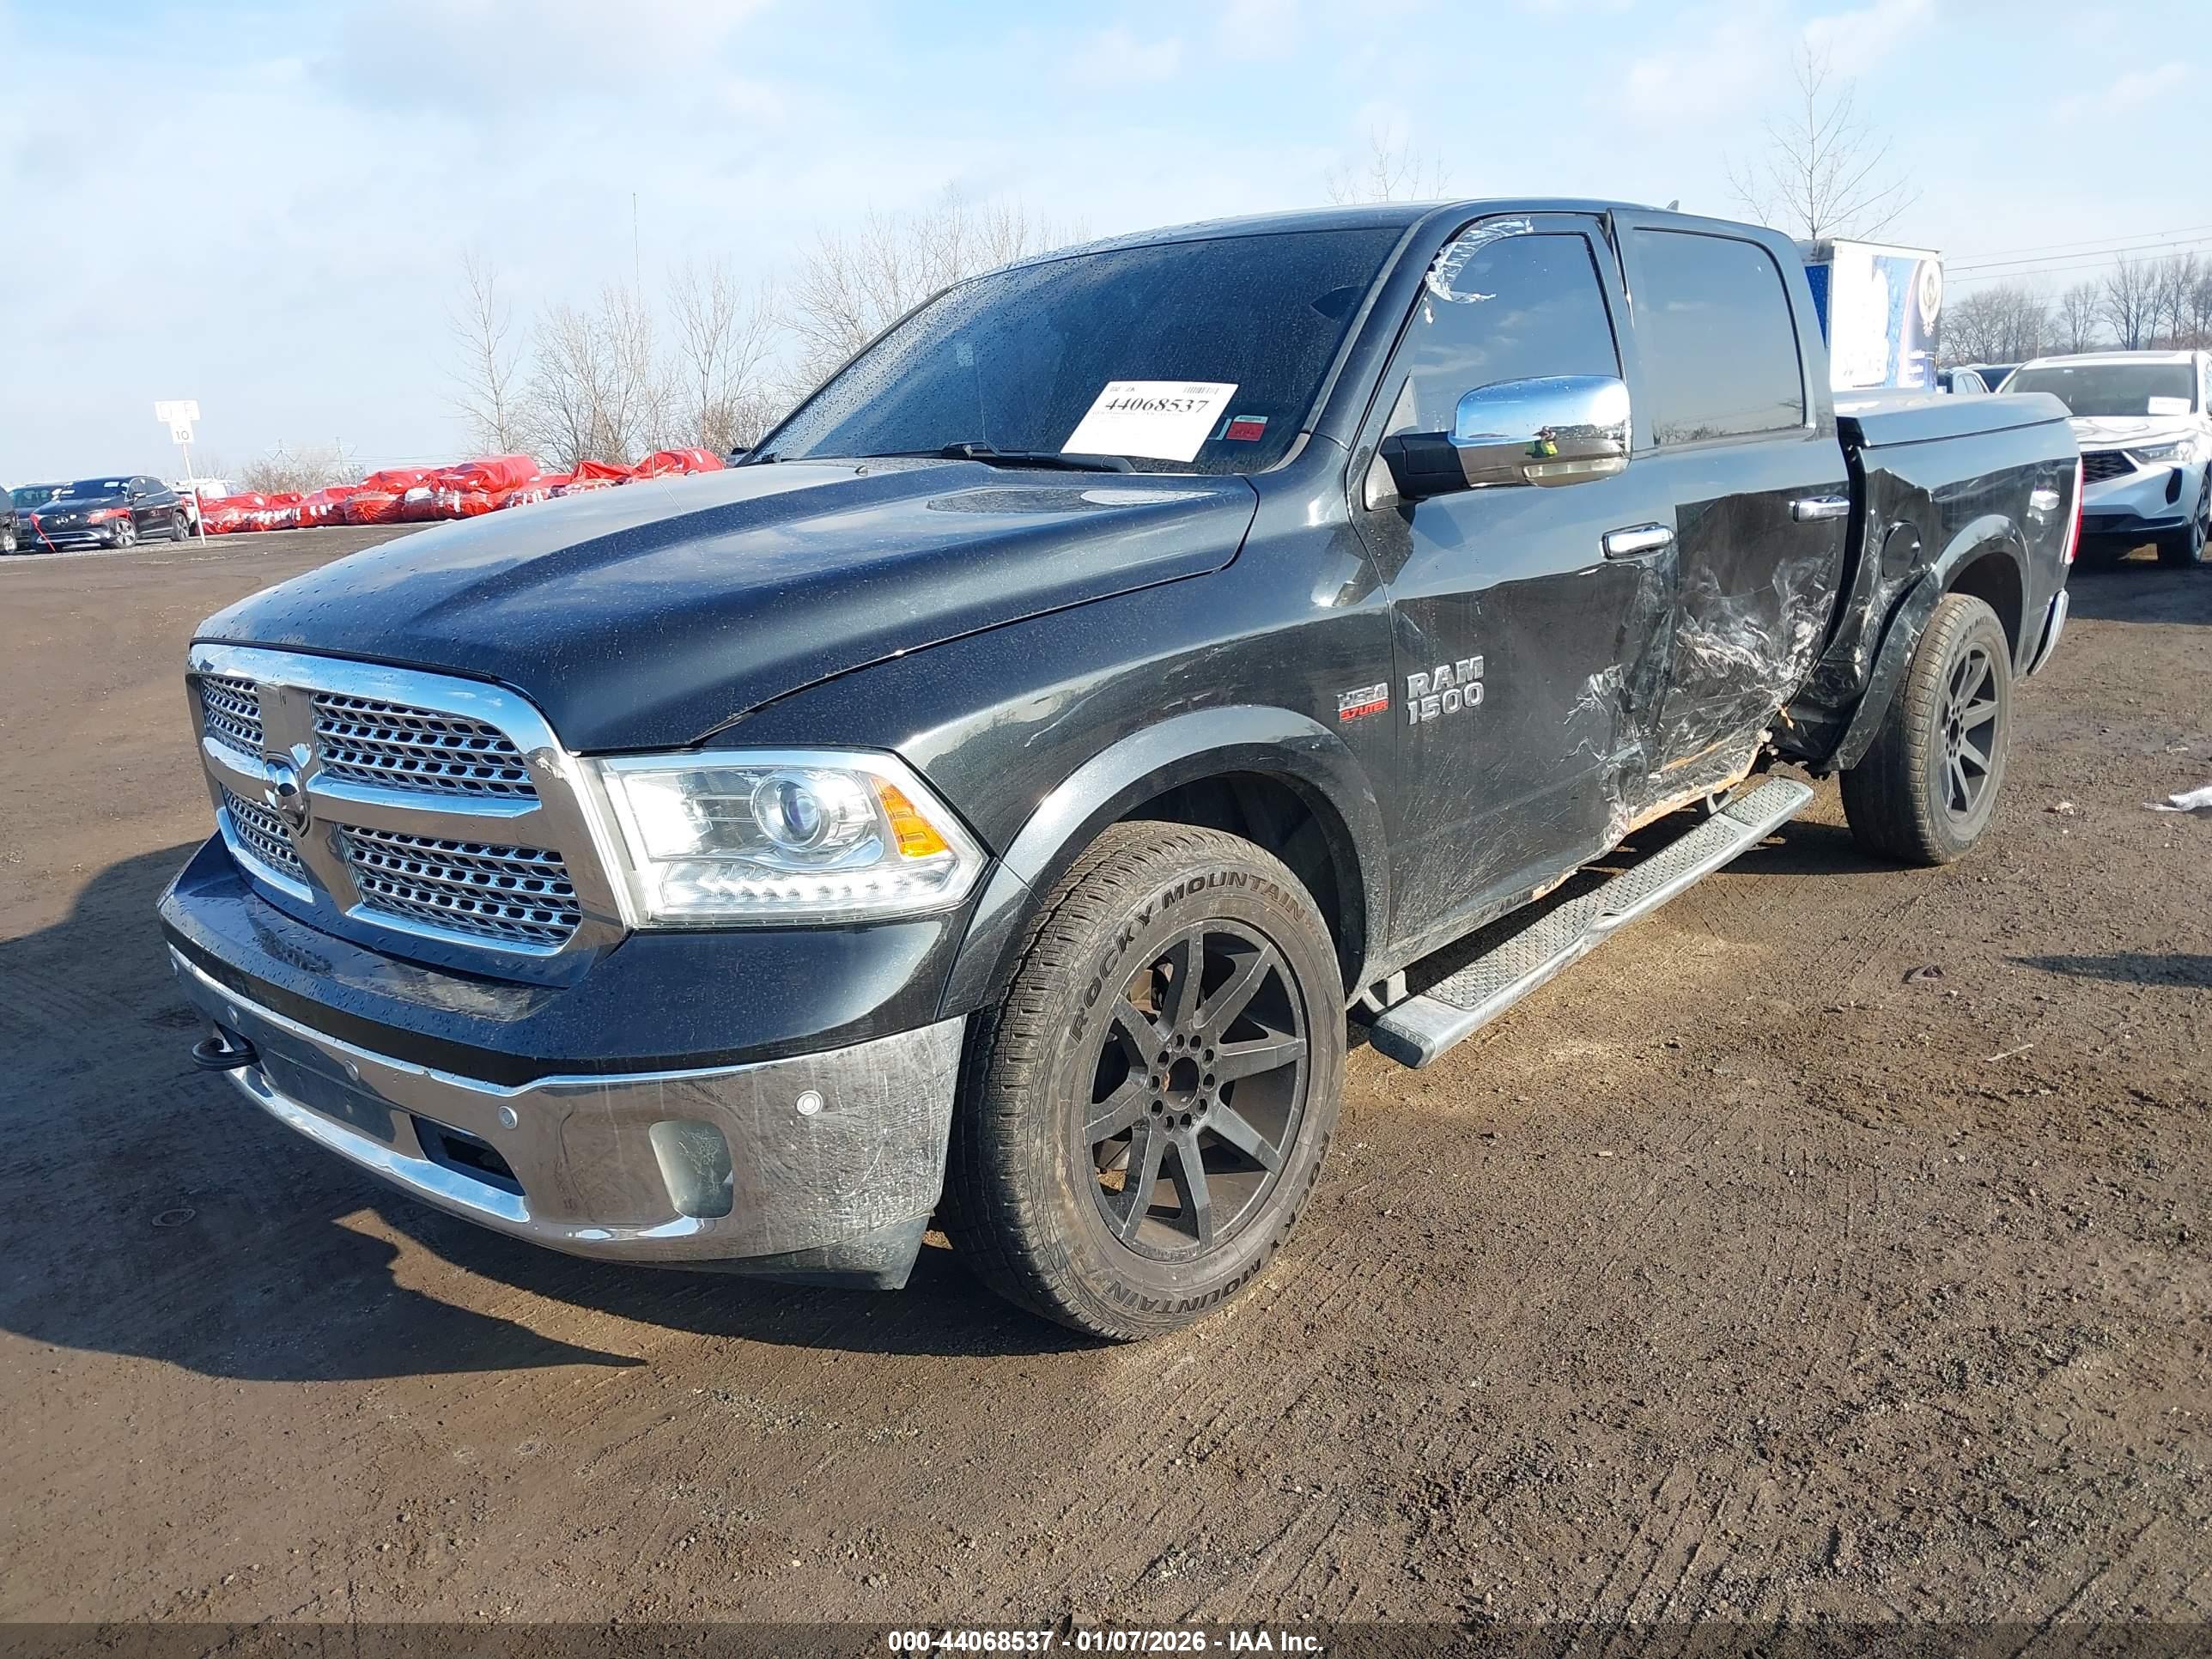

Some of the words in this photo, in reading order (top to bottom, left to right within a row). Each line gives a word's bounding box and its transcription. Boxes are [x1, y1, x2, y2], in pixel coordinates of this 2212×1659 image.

[1104, 397, 1210, 413] 44068537
[175, 430, 190, 441] 10
[1407, 655, 1485, 700] RAM
[1358, 699, 1389, 716] LITER
[1407, 682, 1485, 726] 1500
[1068, 900, 1155, 1045] ROCKY
[1161, 871, 1306, 922] MOUNTAIN
[1103, 1257, 1262, 1315] MOUNTAIN
